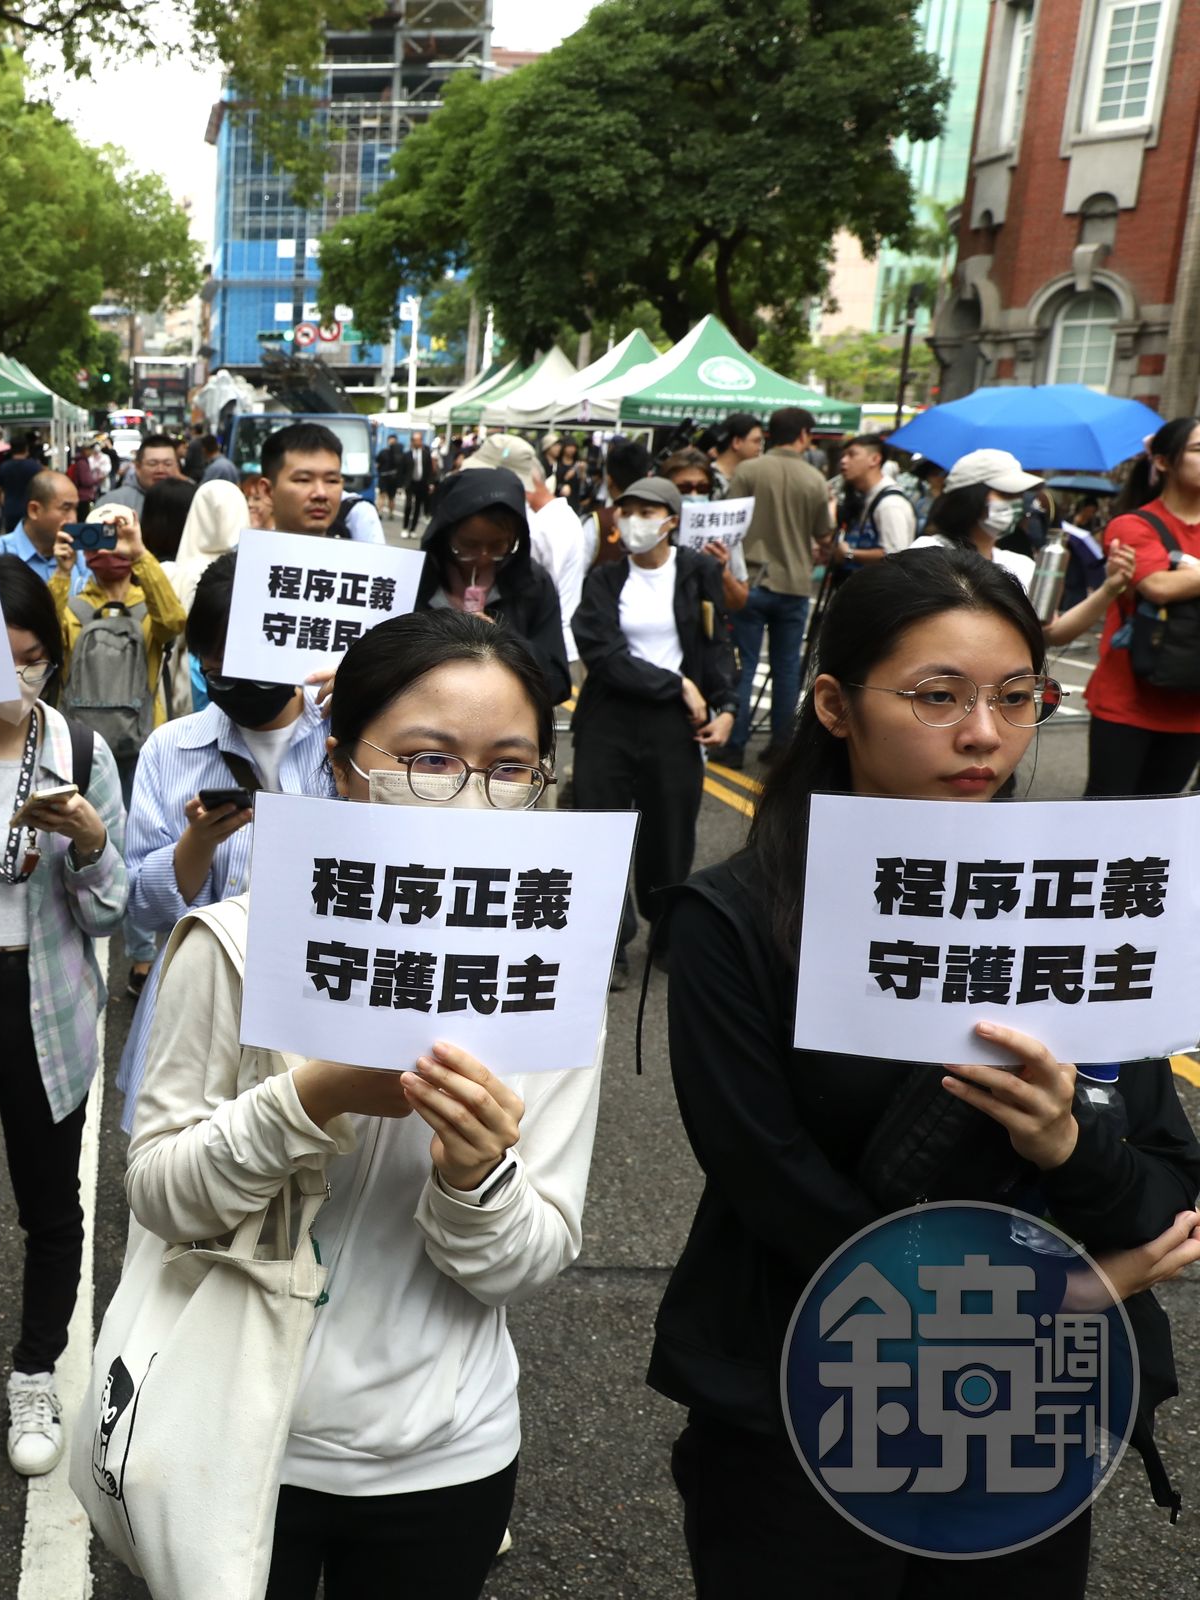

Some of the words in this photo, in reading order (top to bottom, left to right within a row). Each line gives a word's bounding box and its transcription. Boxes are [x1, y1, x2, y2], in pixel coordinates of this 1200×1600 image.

[690, 510, 746, 528] 沒有討論
[268, 565, 397, 611] 程序正義
[262, 612, 374, 652] 守護民
[311, 857, 573, 930] 程序正義
[873, 856, 1170, 920] 程序正義
[305, 940, 560, 1015] 守護民主
[868, 939, 1157, 1006] 守護民主
